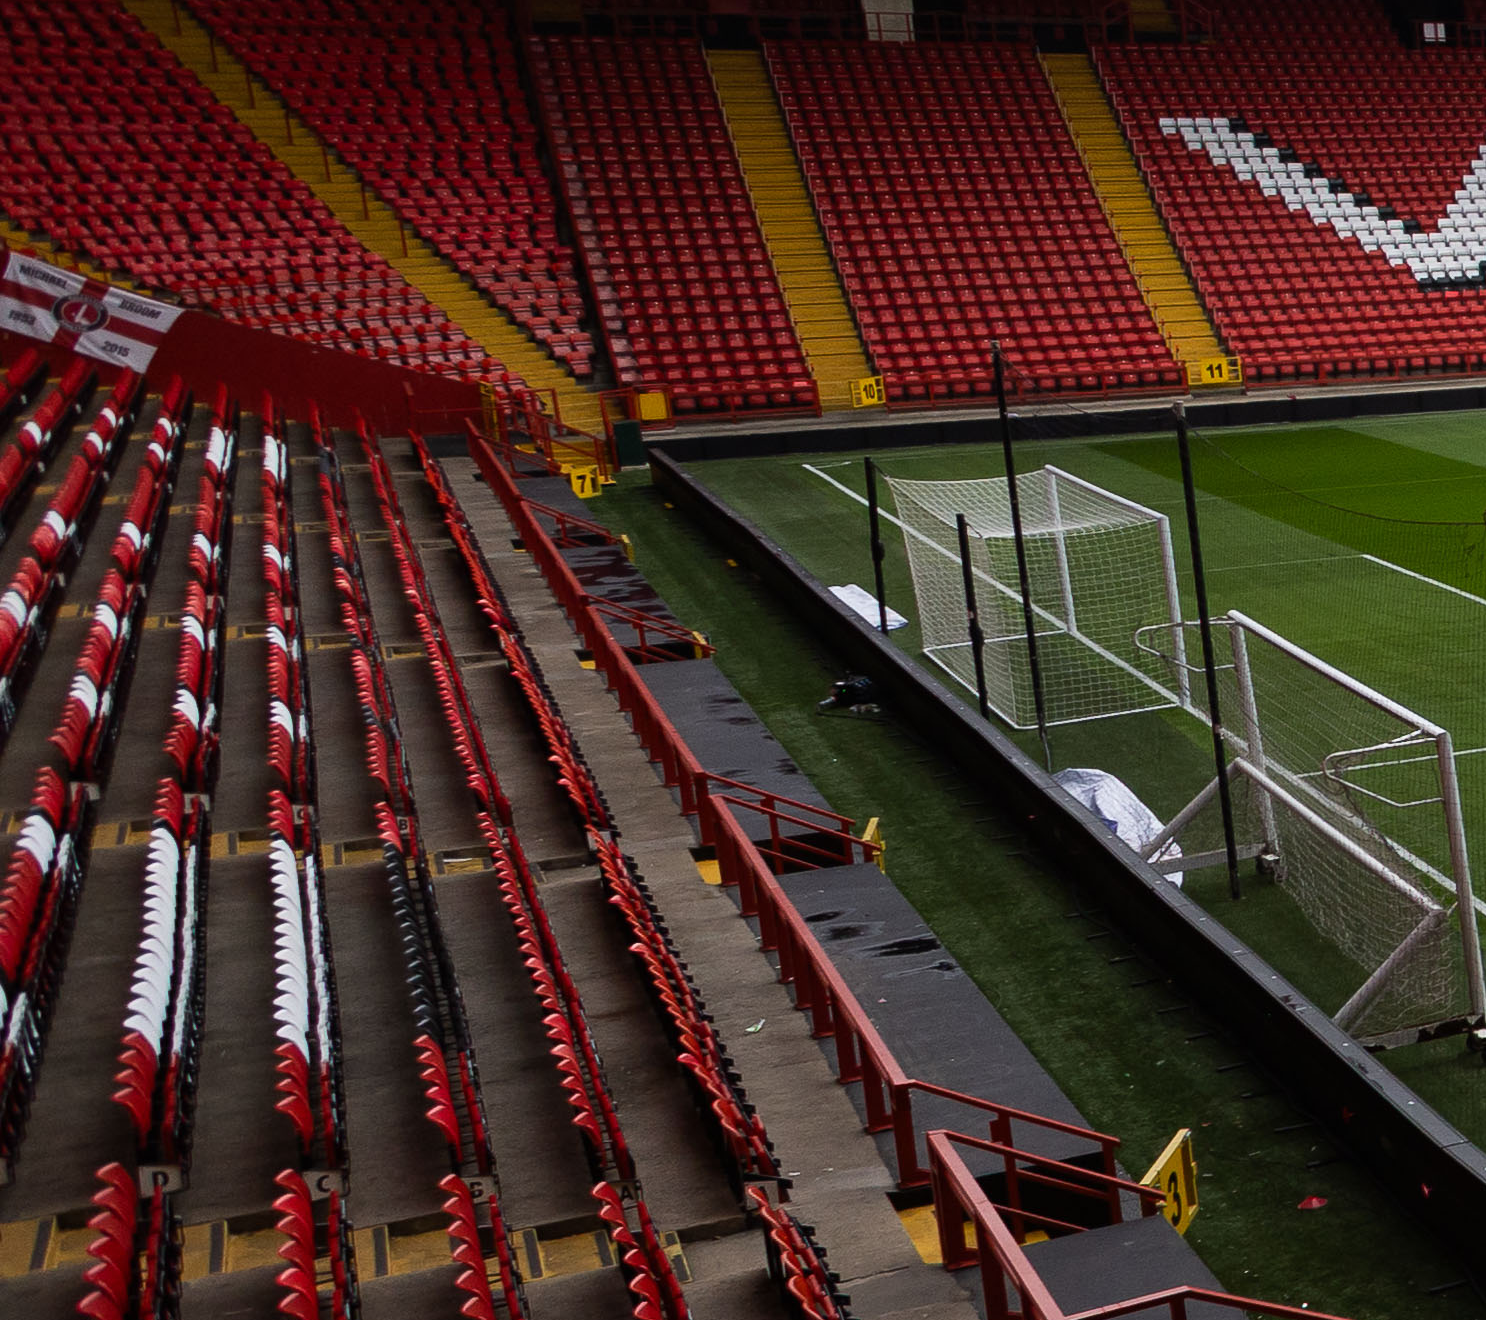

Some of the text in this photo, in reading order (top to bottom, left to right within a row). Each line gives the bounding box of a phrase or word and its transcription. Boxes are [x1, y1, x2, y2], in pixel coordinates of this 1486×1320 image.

[19, 264, 67, 290] MICHAEL
[119, 298, 162, 320] BROOM
[102, 340, 130, 358] 2015
[1206, 363, 1223, 378] 11
[863, 383, 876, 400] 10
[578, 474, 588, 493] 7
[619, 1185, 634, 1201] A
[1168, 1171, 1182, 1227] 3
